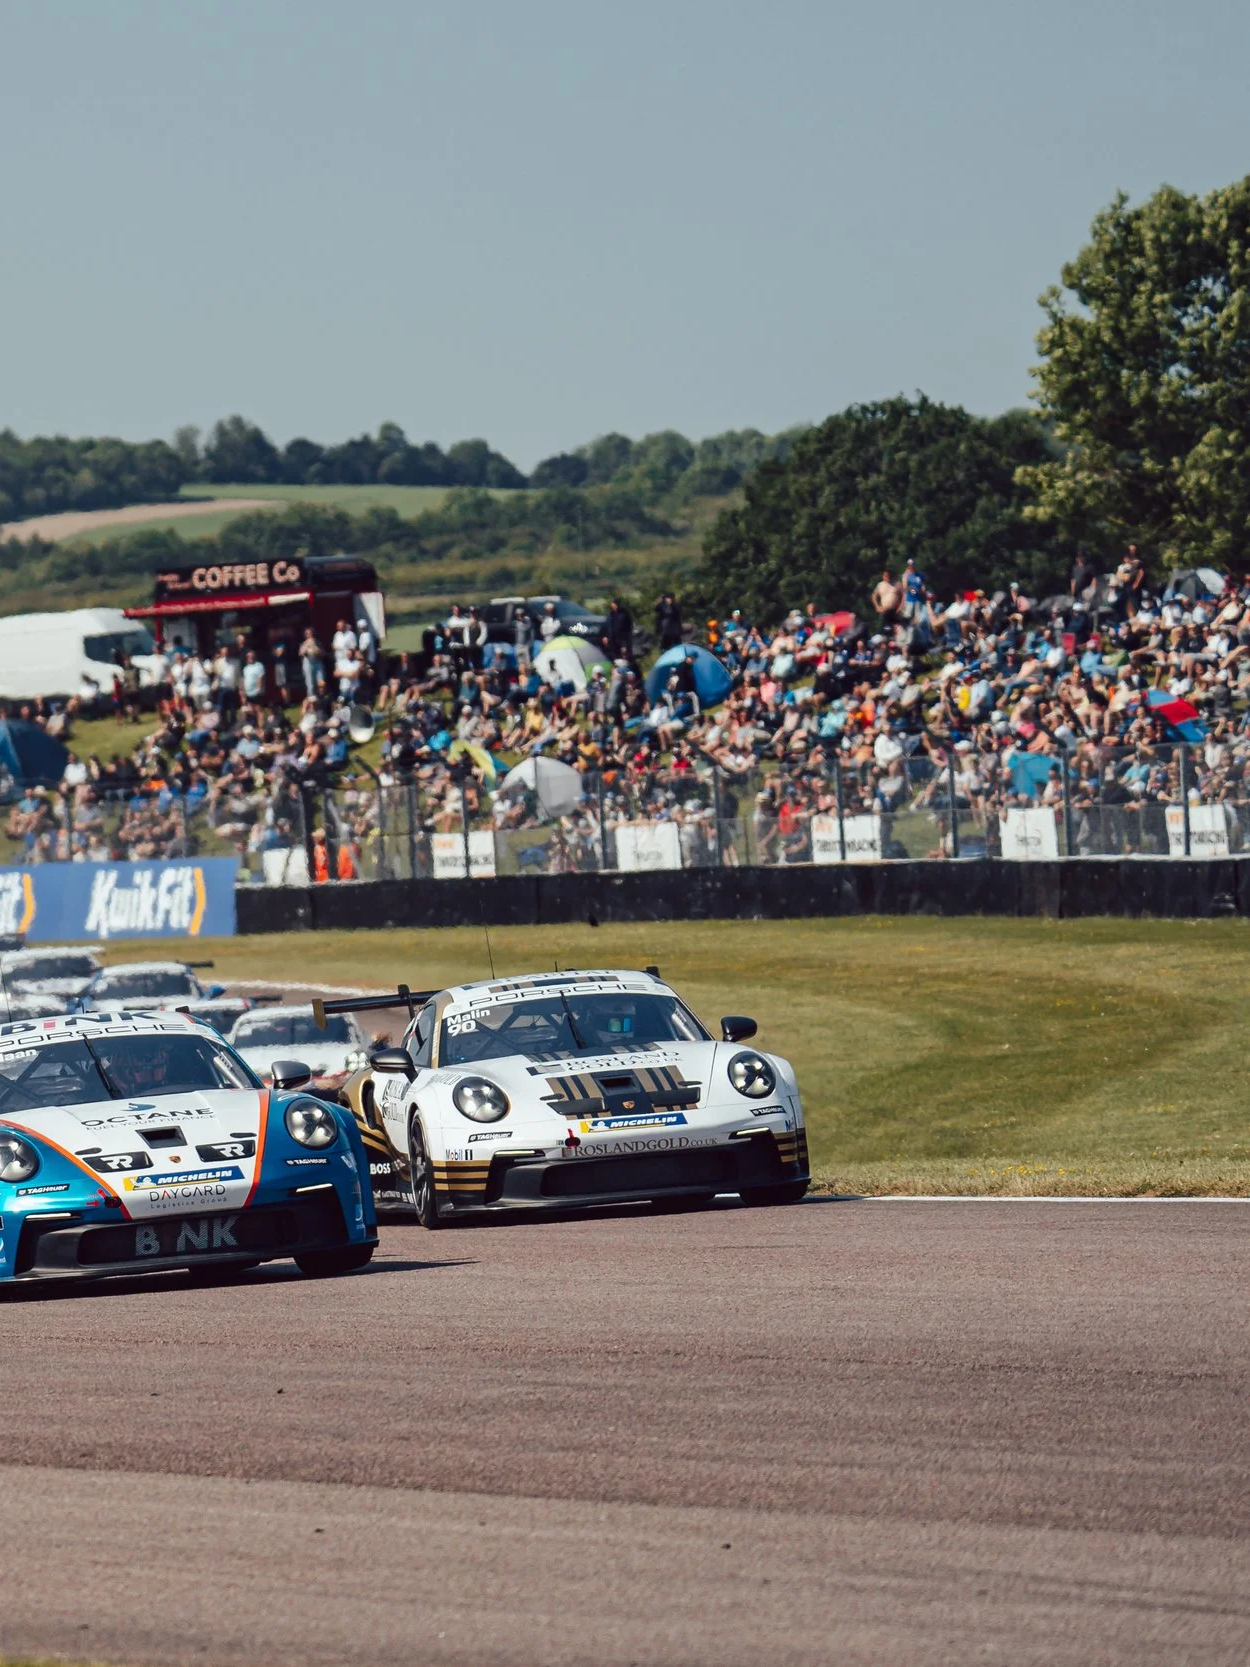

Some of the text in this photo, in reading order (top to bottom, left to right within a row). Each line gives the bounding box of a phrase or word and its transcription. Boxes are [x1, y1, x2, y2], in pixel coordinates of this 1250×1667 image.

[192, 562, 270, 589] COFFEE
[272, 561, 300, 583] Co
[470, 983, 648, 1007] PORSCHE
[446, 1008, 490, 1026] Malin
[448, 1020, 477, 1036] 90
[80, 1106, 214, 1127] OCTANE
[610, 1116, 678, 1129] MICHELIN
[446, 1149, 473, 1160] Mobil 1
[157, 1170, 233, 1184] MICHELIN
[370, 1162, 391, 1175] BOSS
[135, 1216, 239, 1257] BNK
